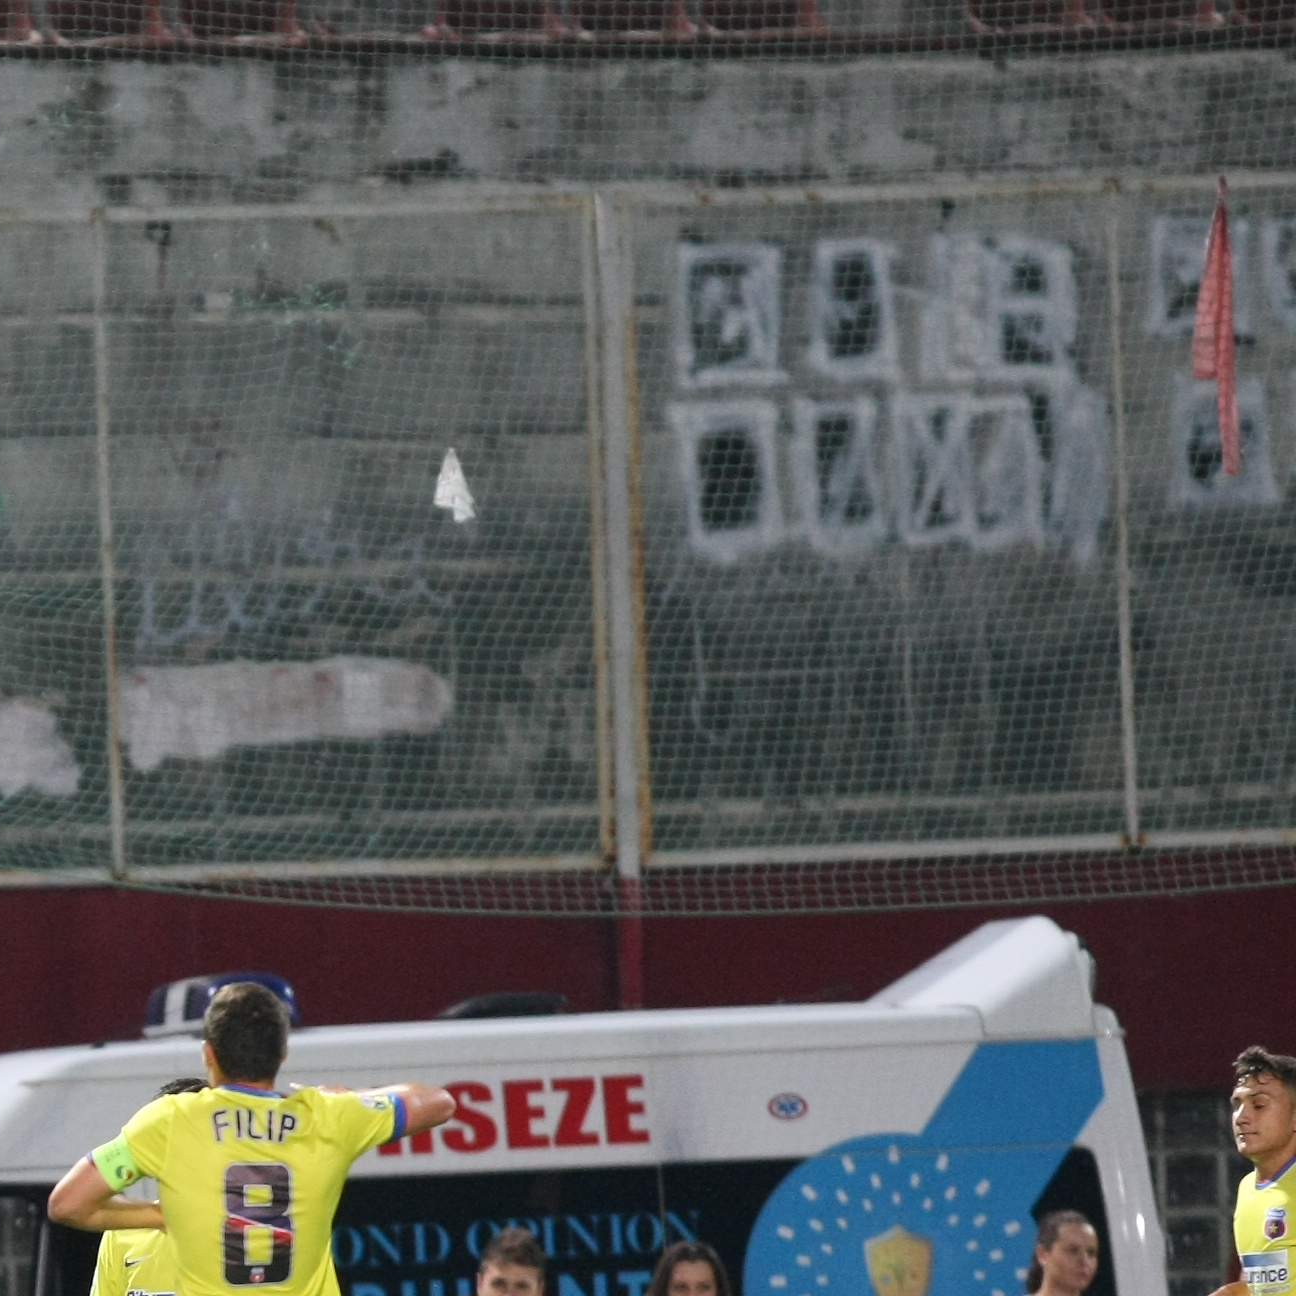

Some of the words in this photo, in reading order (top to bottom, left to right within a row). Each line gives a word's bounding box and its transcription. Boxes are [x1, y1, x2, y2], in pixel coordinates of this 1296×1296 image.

[212, 1109, 297, 1142] FILIP
[377, 1074, 650, 1156] SEZE
[222, 1161, 293, 1287] 8
